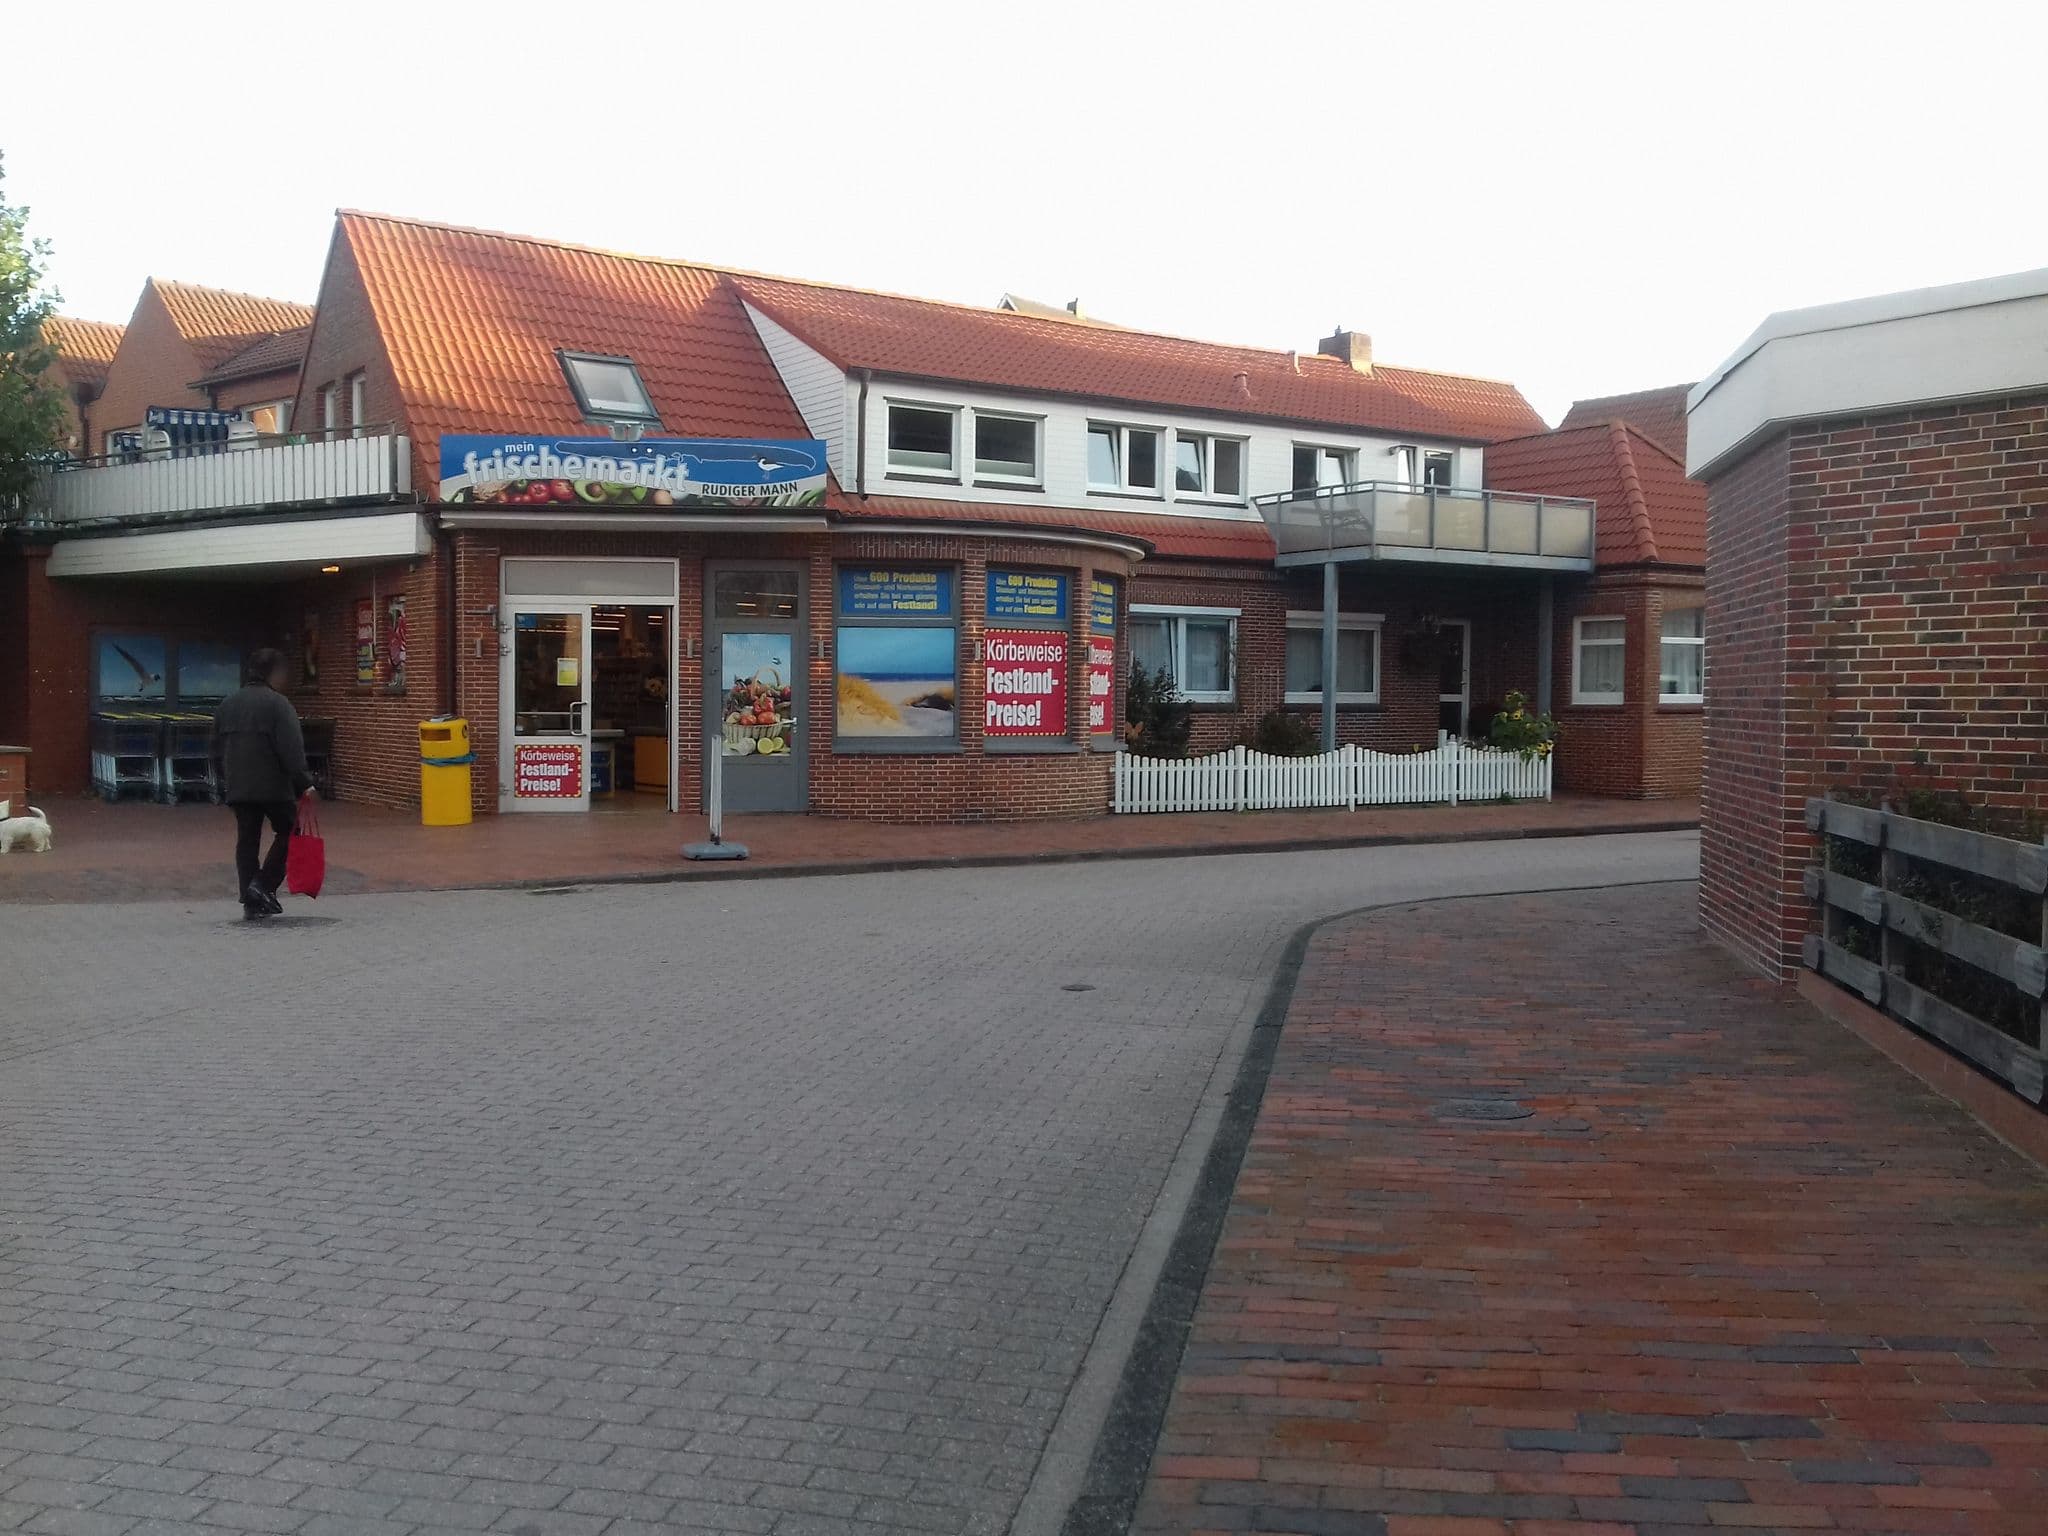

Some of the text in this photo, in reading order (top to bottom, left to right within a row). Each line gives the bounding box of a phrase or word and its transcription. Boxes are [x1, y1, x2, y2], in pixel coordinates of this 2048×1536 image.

[505, 441, 535, 453] mein
[463, 445, 690, 492] frischemarkt
[760, 482, 799, 496] MANN
[986, 639, 1063, 662] Körbeweise
[986, 667, 1059, 694] Festland-
[986, 700, 1042, 727] Preise!
[521, 750, 575, 761] Körbeweise
[520, 763, 574, 776] Festland-
[520, 778, 561, 791] Preise!
